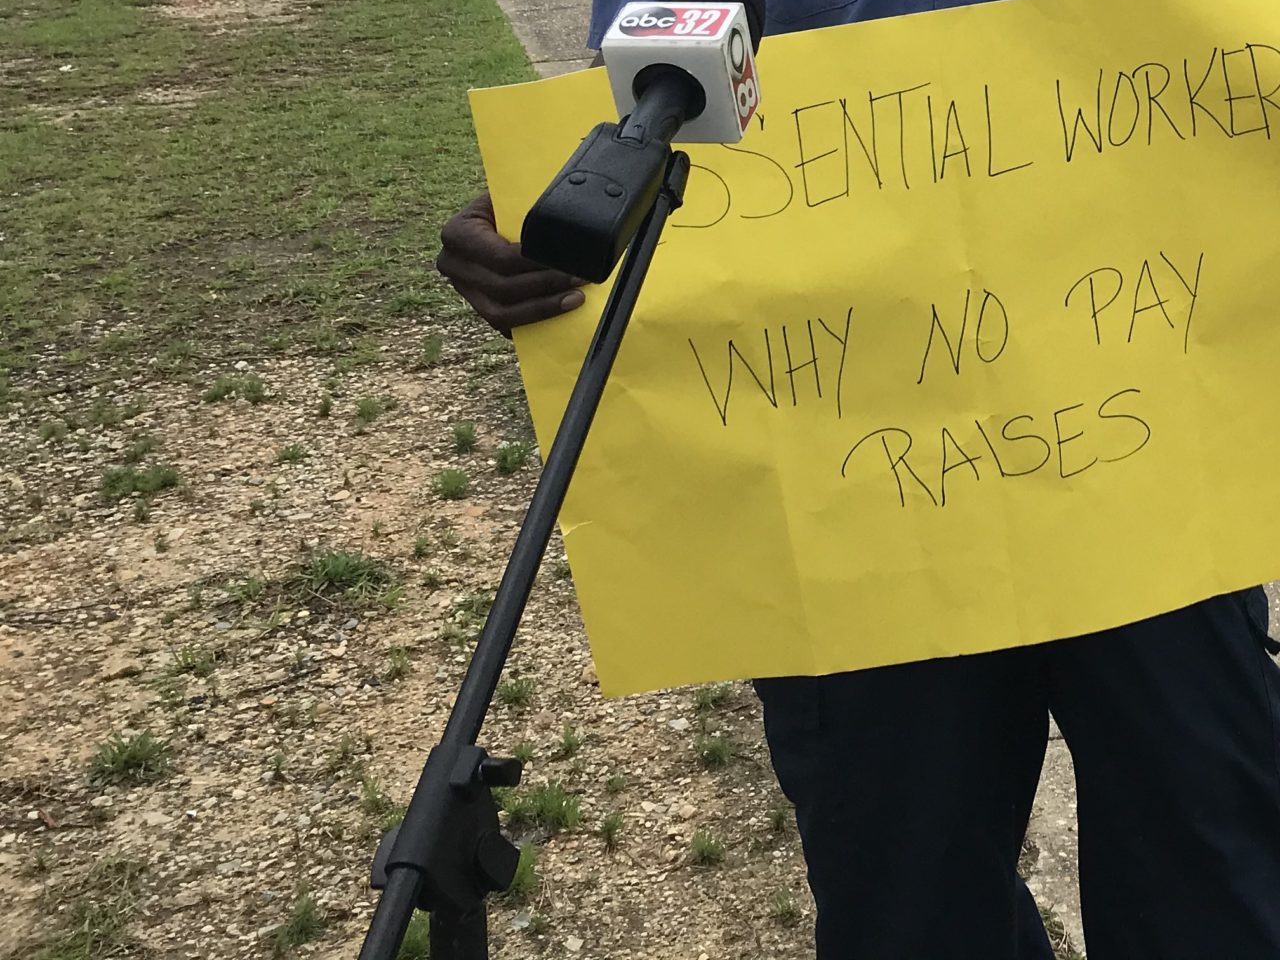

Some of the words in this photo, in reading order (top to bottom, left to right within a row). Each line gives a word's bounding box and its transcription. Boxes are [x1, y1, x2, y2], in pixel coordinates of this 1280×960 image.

[620, 13, 676, 29] abc
[673, 8, 721, 36] 32
[688, 306, 853, 427] WHY
[917, 288, 1009, 385] NO
[1065, 251, 1204, 355] PAY
[842, 388, 1151, 508] RAISES
